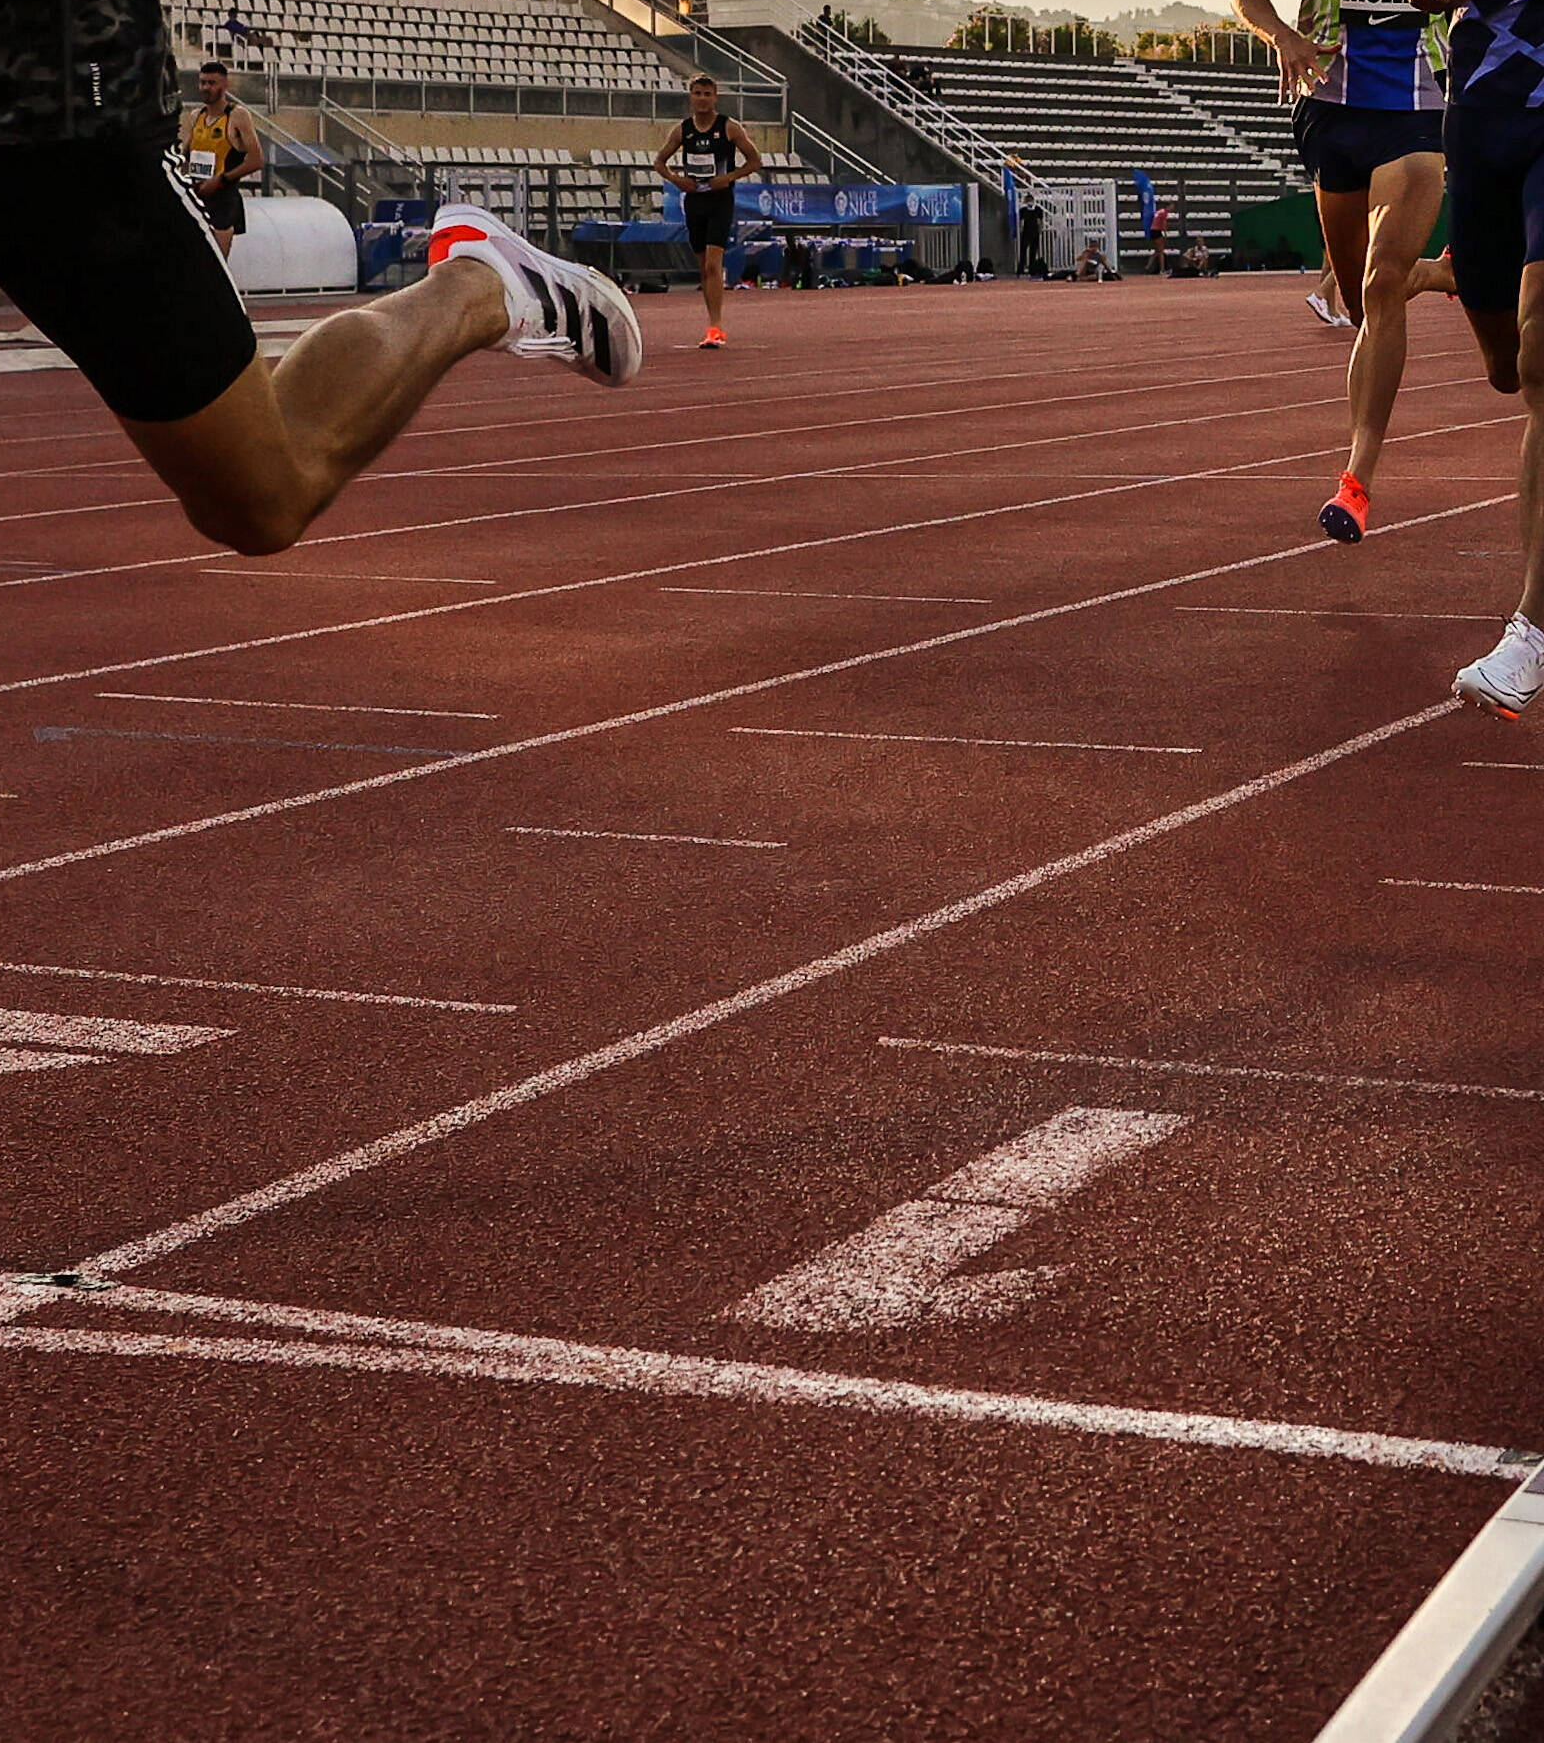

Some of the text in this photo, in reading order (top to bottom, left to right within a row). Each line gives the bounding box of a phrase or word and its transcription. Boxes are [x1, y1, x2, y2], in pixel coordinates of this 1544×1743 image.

[773, 199, 805, 216] NICE
[848, 200, 879, 216] NICE
[920, 201, 949, 217] NICE
[723, 1103, 1192, 1334] 1
